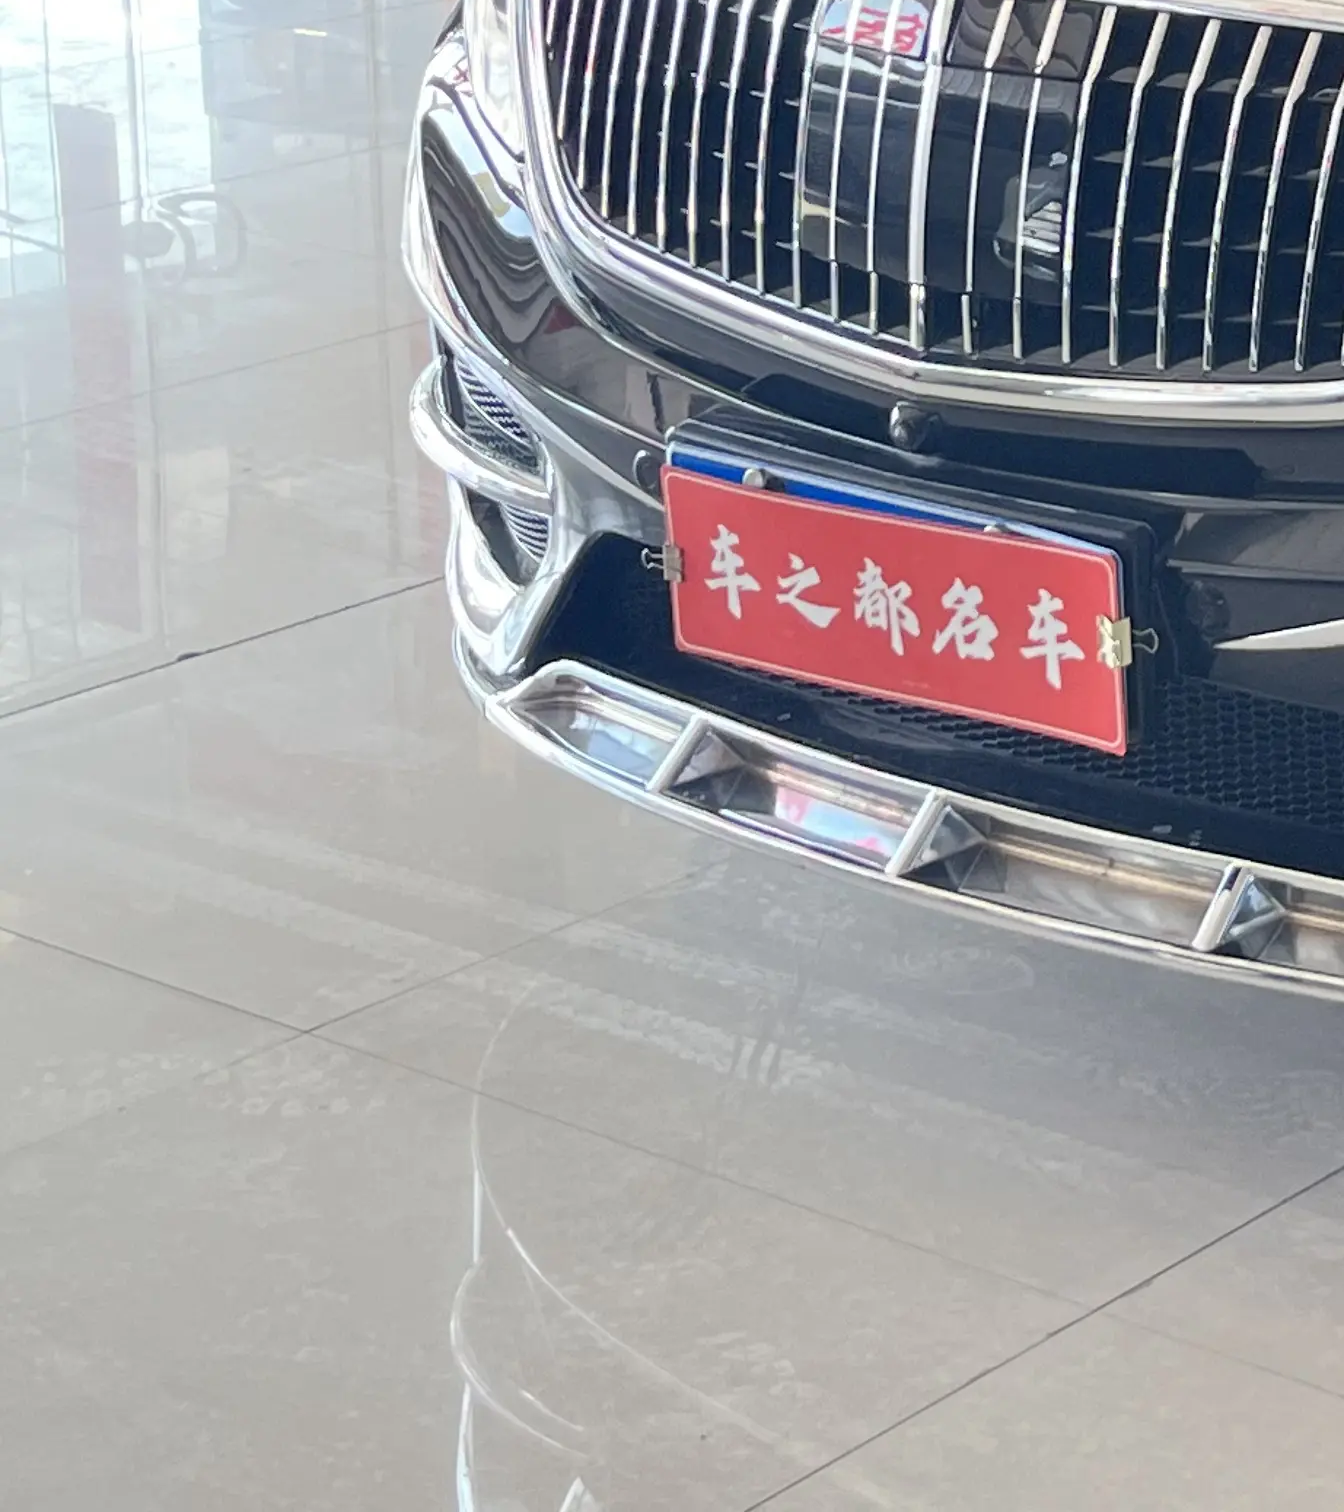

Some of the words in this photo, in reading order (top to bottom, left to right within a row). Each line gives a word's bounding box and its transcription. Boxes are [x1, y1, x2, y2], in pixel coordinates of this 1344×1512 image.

[704, 524, 1084, 689] 车之都名车
